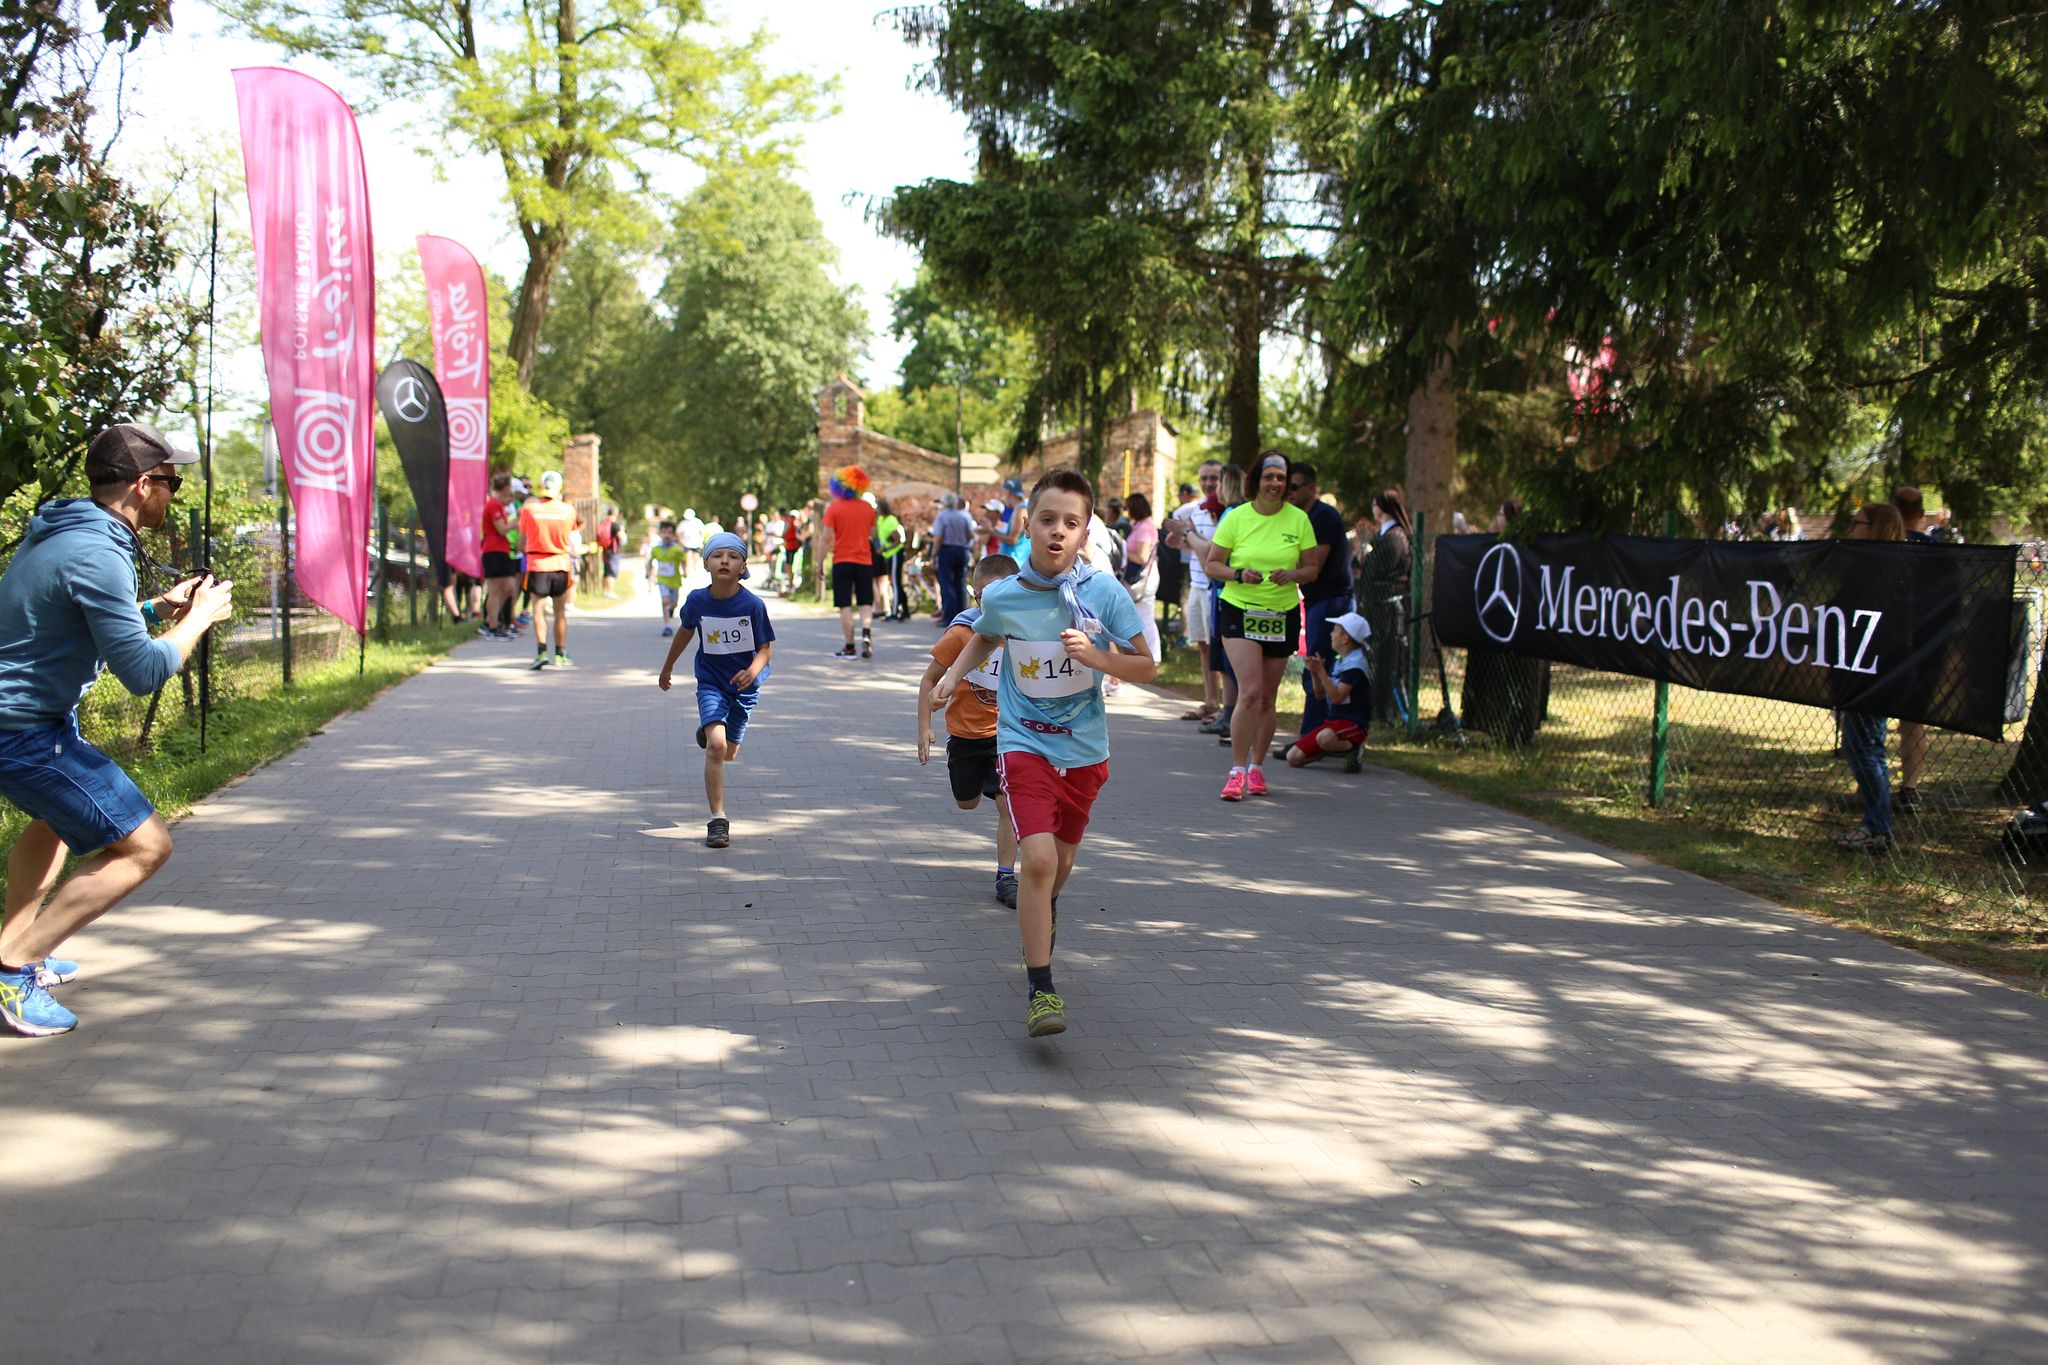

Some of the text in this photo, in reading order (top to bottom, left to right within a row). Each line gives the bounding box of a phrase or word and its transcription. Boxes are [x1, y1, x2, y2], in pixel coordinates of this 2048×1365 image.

[1245, 618, 1284, 634] 268
[1535, 565, 1883, 675] Mercedes-Benz
[721, 629, 742, 644] 19
[1043, 657, 1074, 679] 14
